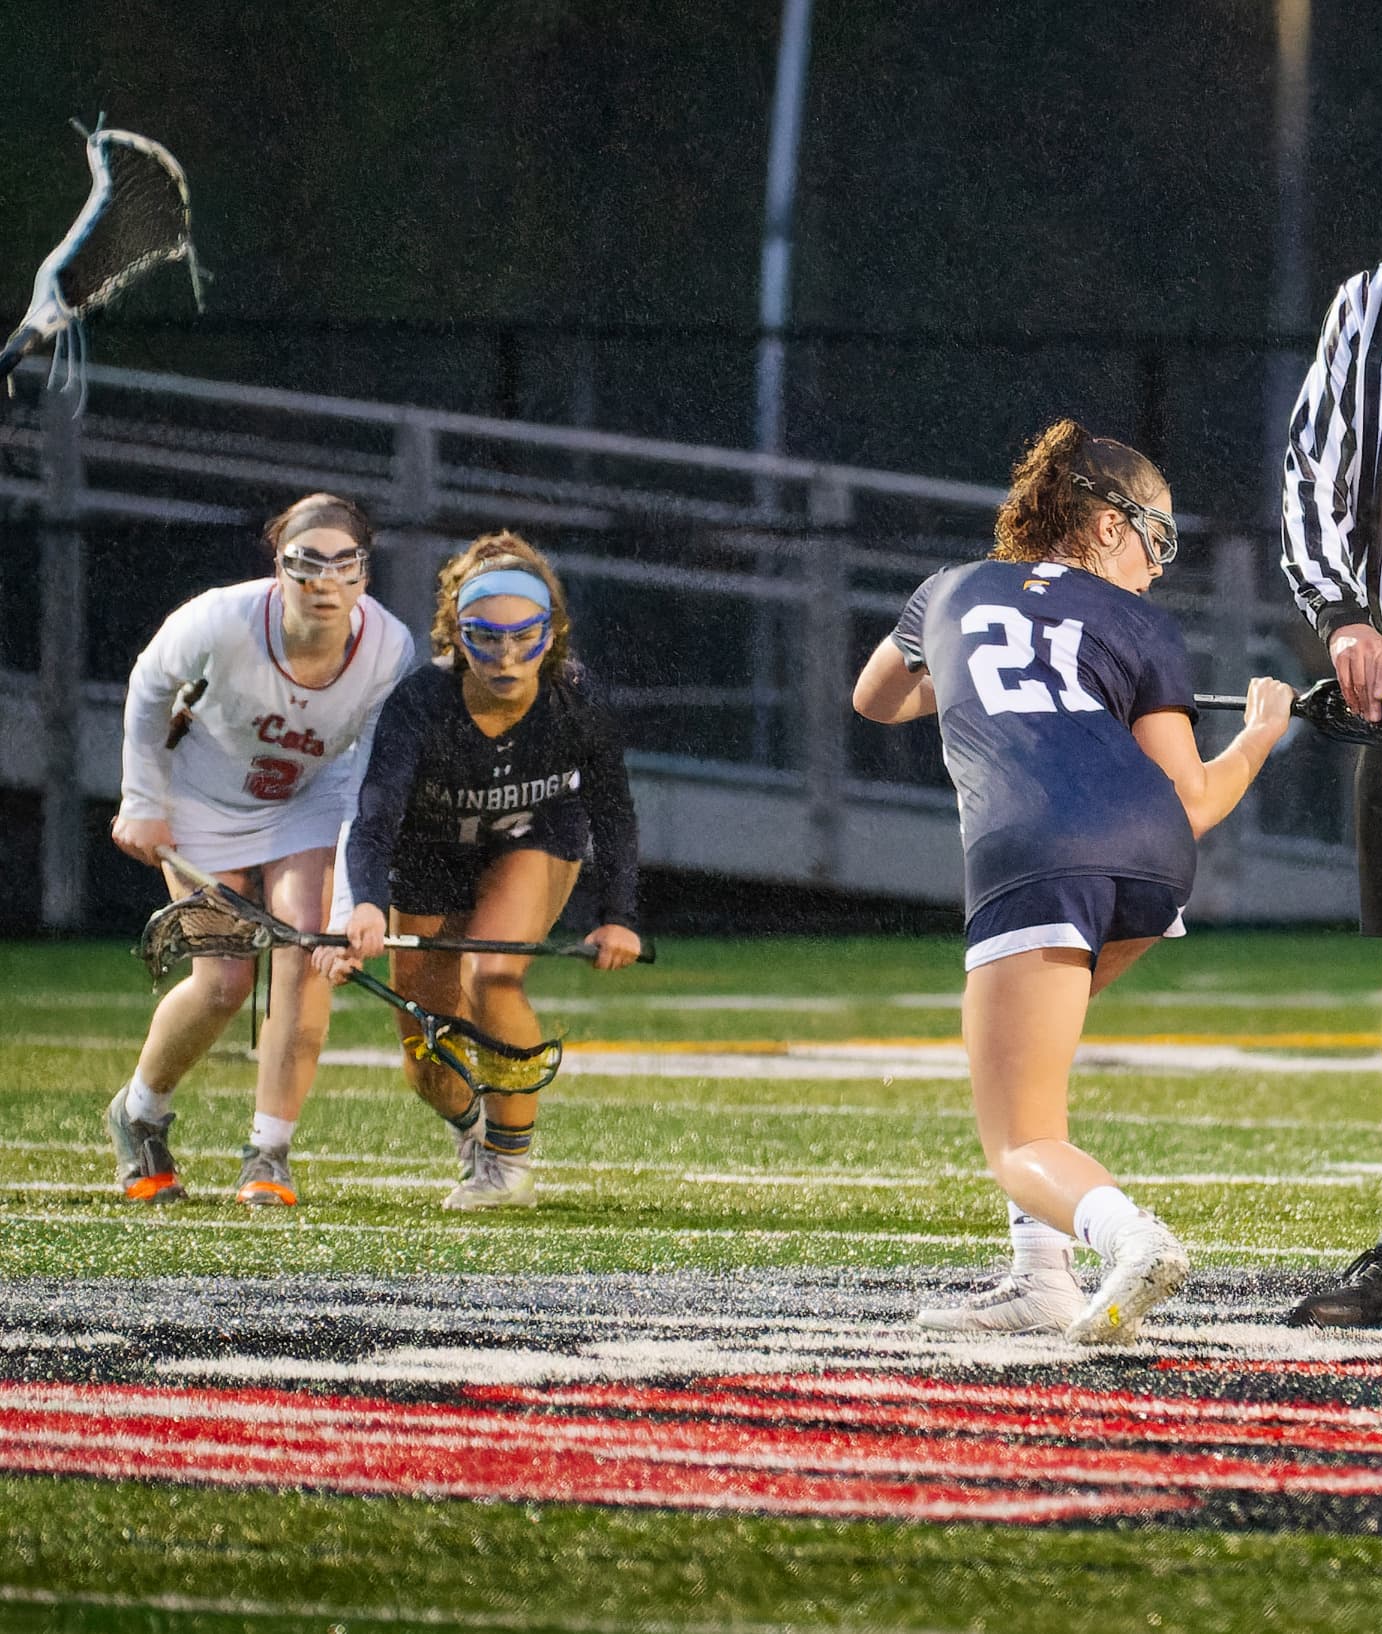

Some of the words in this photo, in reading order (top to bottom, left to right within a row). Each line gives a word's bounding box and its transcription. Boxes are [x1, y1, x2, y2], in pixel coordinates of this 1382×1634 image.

[1070, 471, 1096, 491] TX
[961, 604, 1105, 717] 21
[242, 754, 305, 802] 2
[424, 768, 578, 810] AINBRIDG
